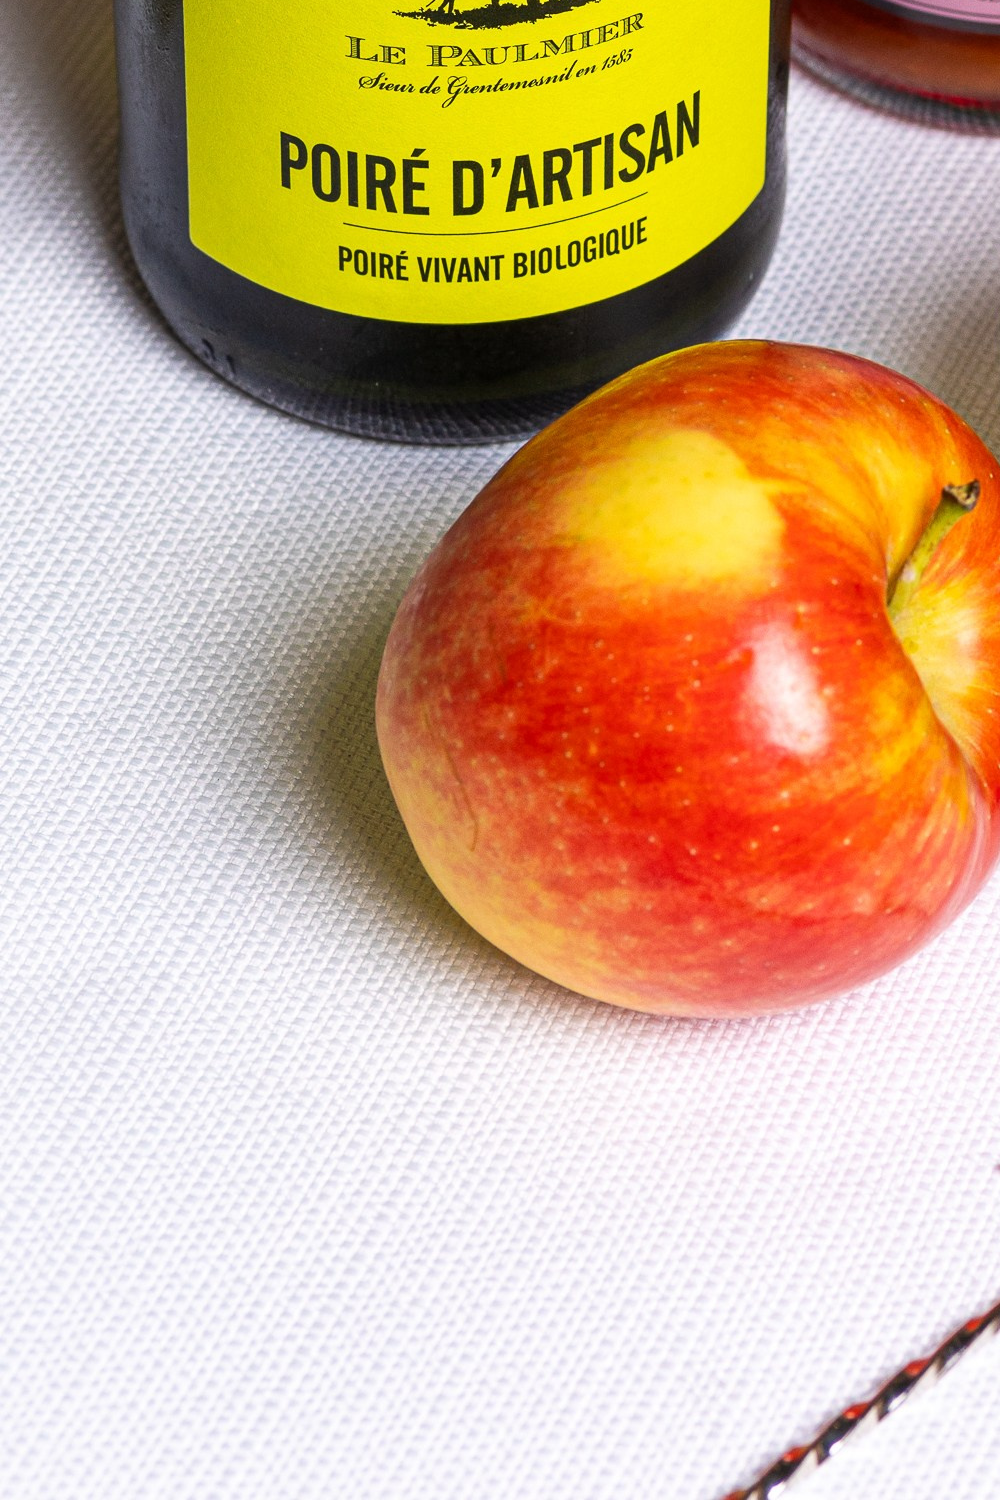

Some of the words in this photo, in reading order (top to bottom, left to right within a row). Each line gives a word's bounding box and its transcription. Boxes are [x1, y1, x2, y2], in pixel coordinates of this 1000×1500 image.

[345, 35, 407, 65] LE
[426, 12, 645, 68] PAULMIER
[358, 72, 415, 93] Sieur
[419, 75, 441, 95] de
[441, 60, 578, 108] Grentemesnil
[576, 65, 598, 78] en
[601, 48, 634, 71] 1585
[280, 131, 430, 217] POIRÉ
[453, 90, 701, 217] D'ARTISAN
[338, 245, 409, 282] POIRÉ
[417, 254, 505, 283] VIVANT
[513, 216, 649, 279] BIOLOGIQUE
